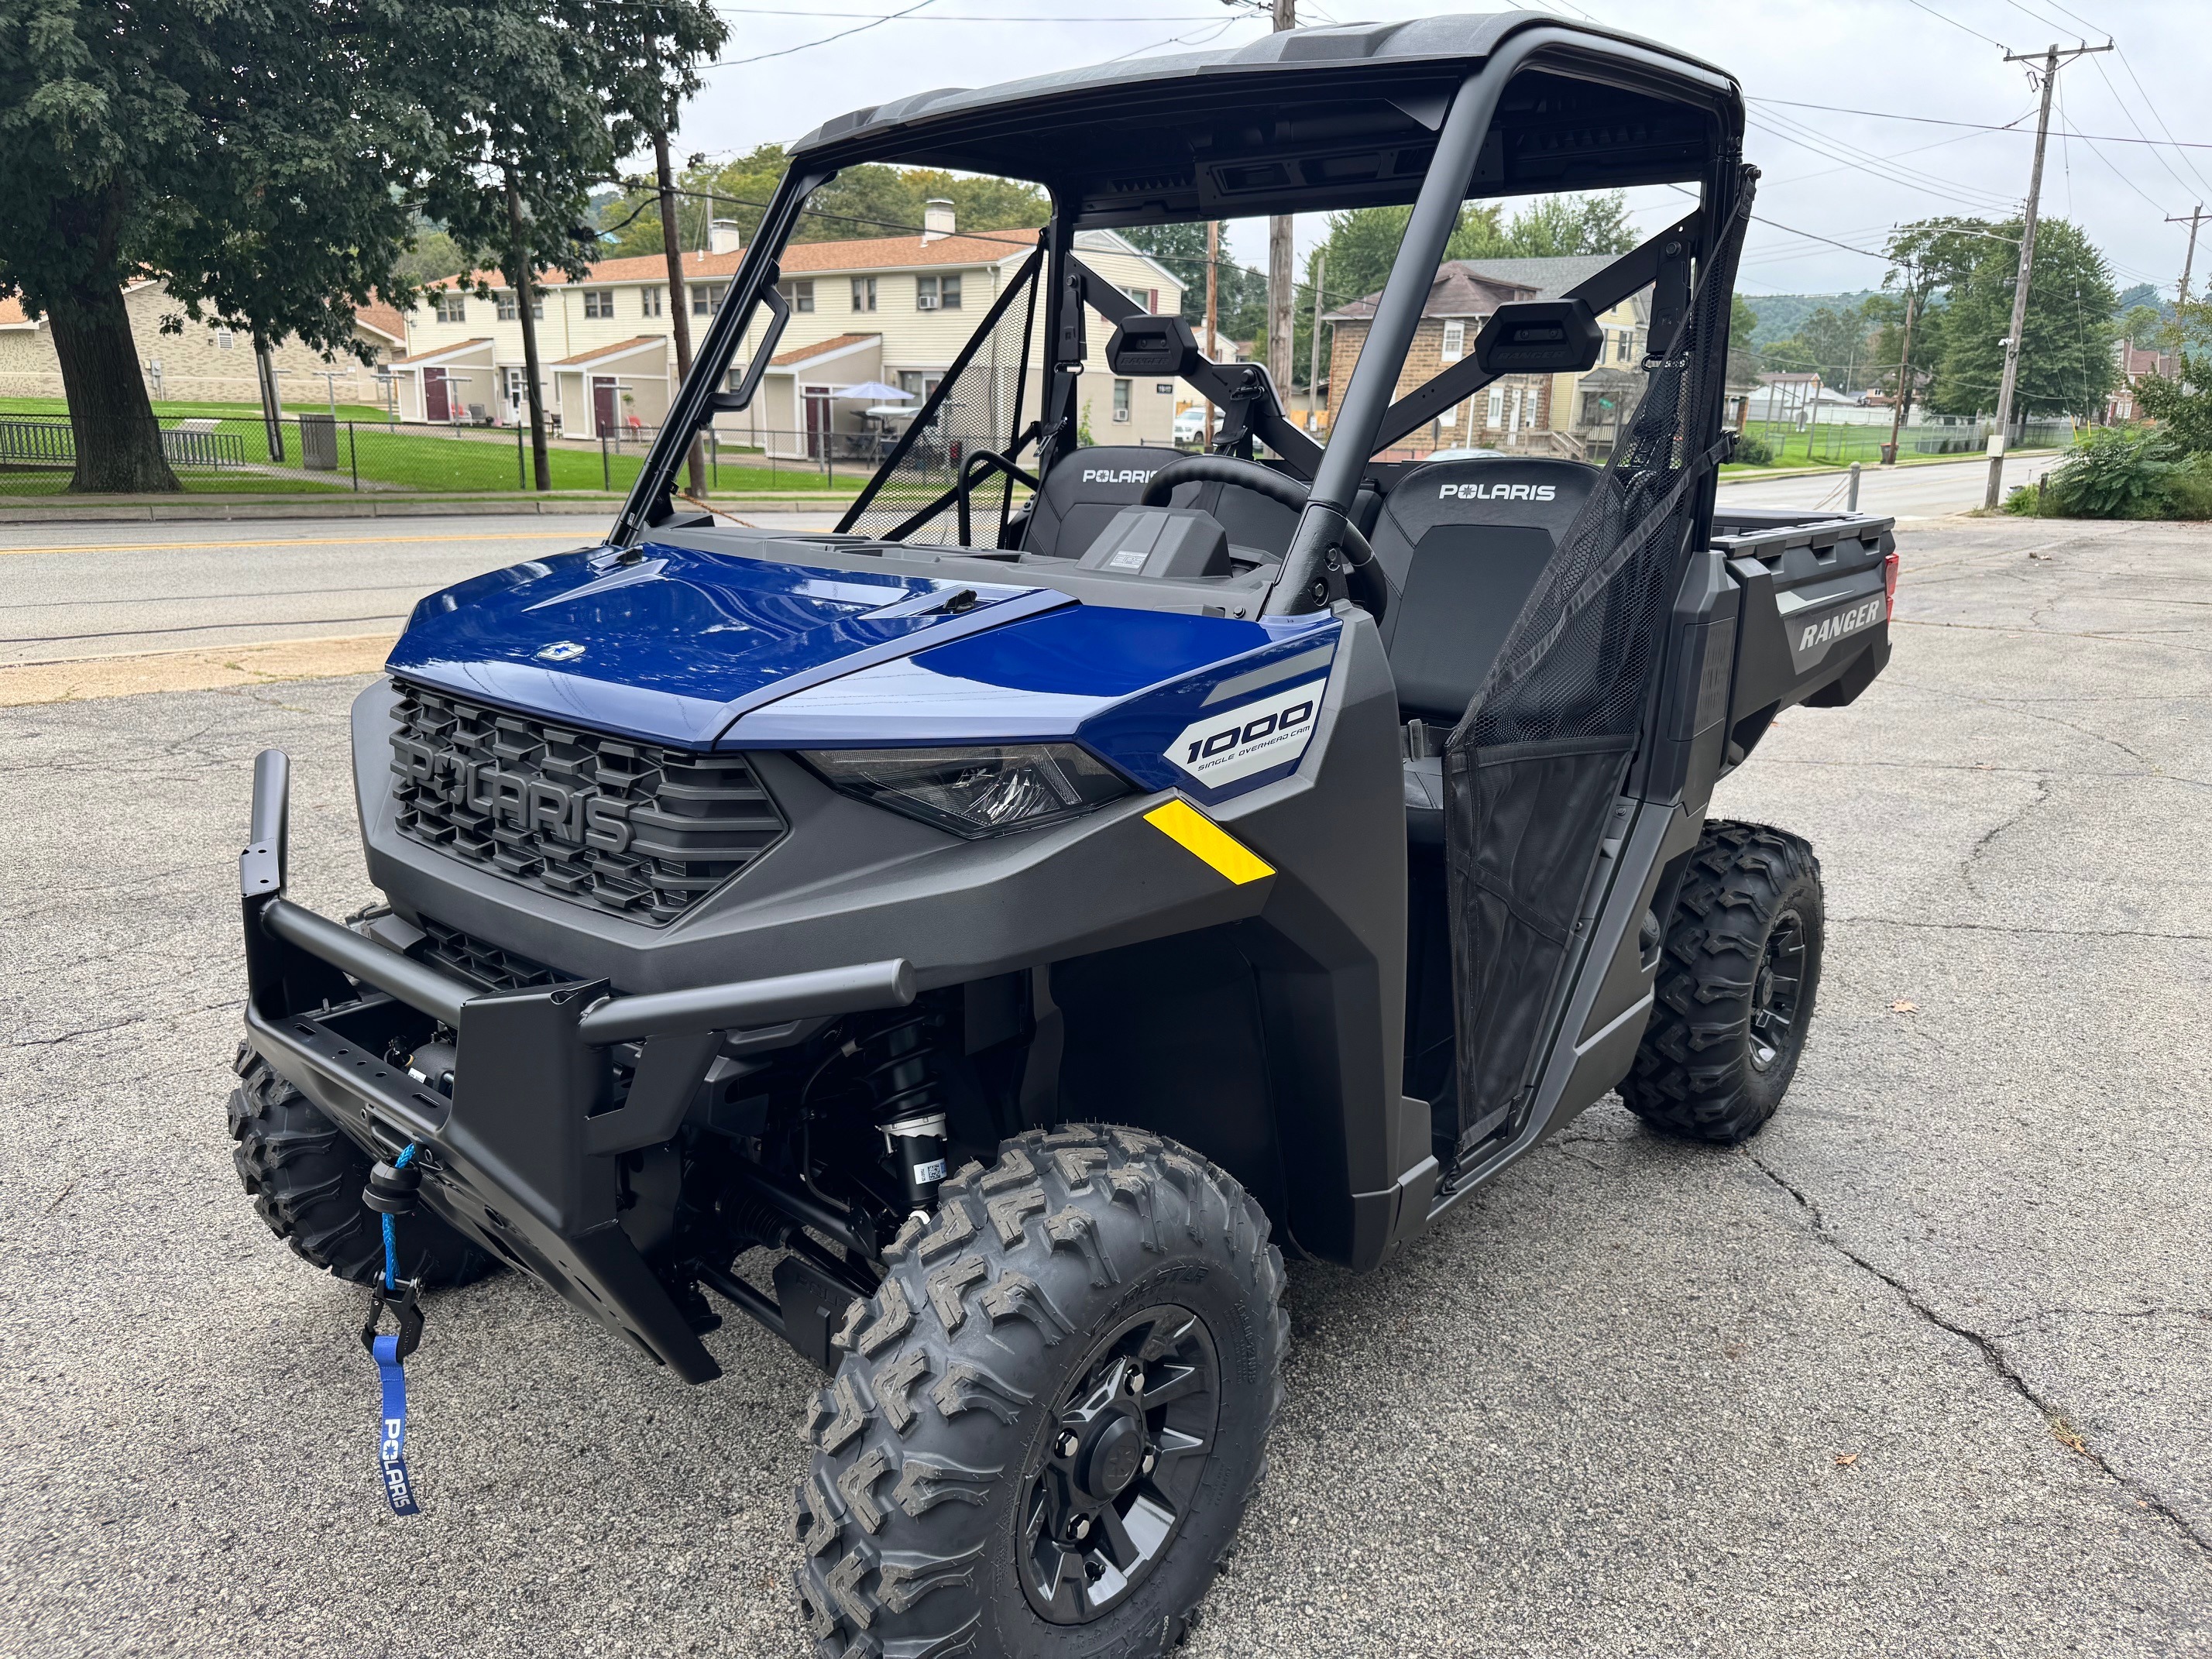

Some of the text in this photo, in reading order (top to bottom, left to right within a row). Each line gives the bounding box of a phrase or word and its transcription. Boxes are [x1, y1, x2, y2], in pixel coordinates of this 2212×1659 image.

[1082, 469, 1158, 483] POLARI
[1438, 483, 1557, 502] POLARIS
[1798, 599, 1880, 652] RANGER
[1187, 699, 1314, 764] 1000
[1197, 725, 1310, 771] SINGLE OVERHEAD CAM
[405, 740, 637, 854] POLARIS
[381, 1418, 411, 1509] POLARIS
